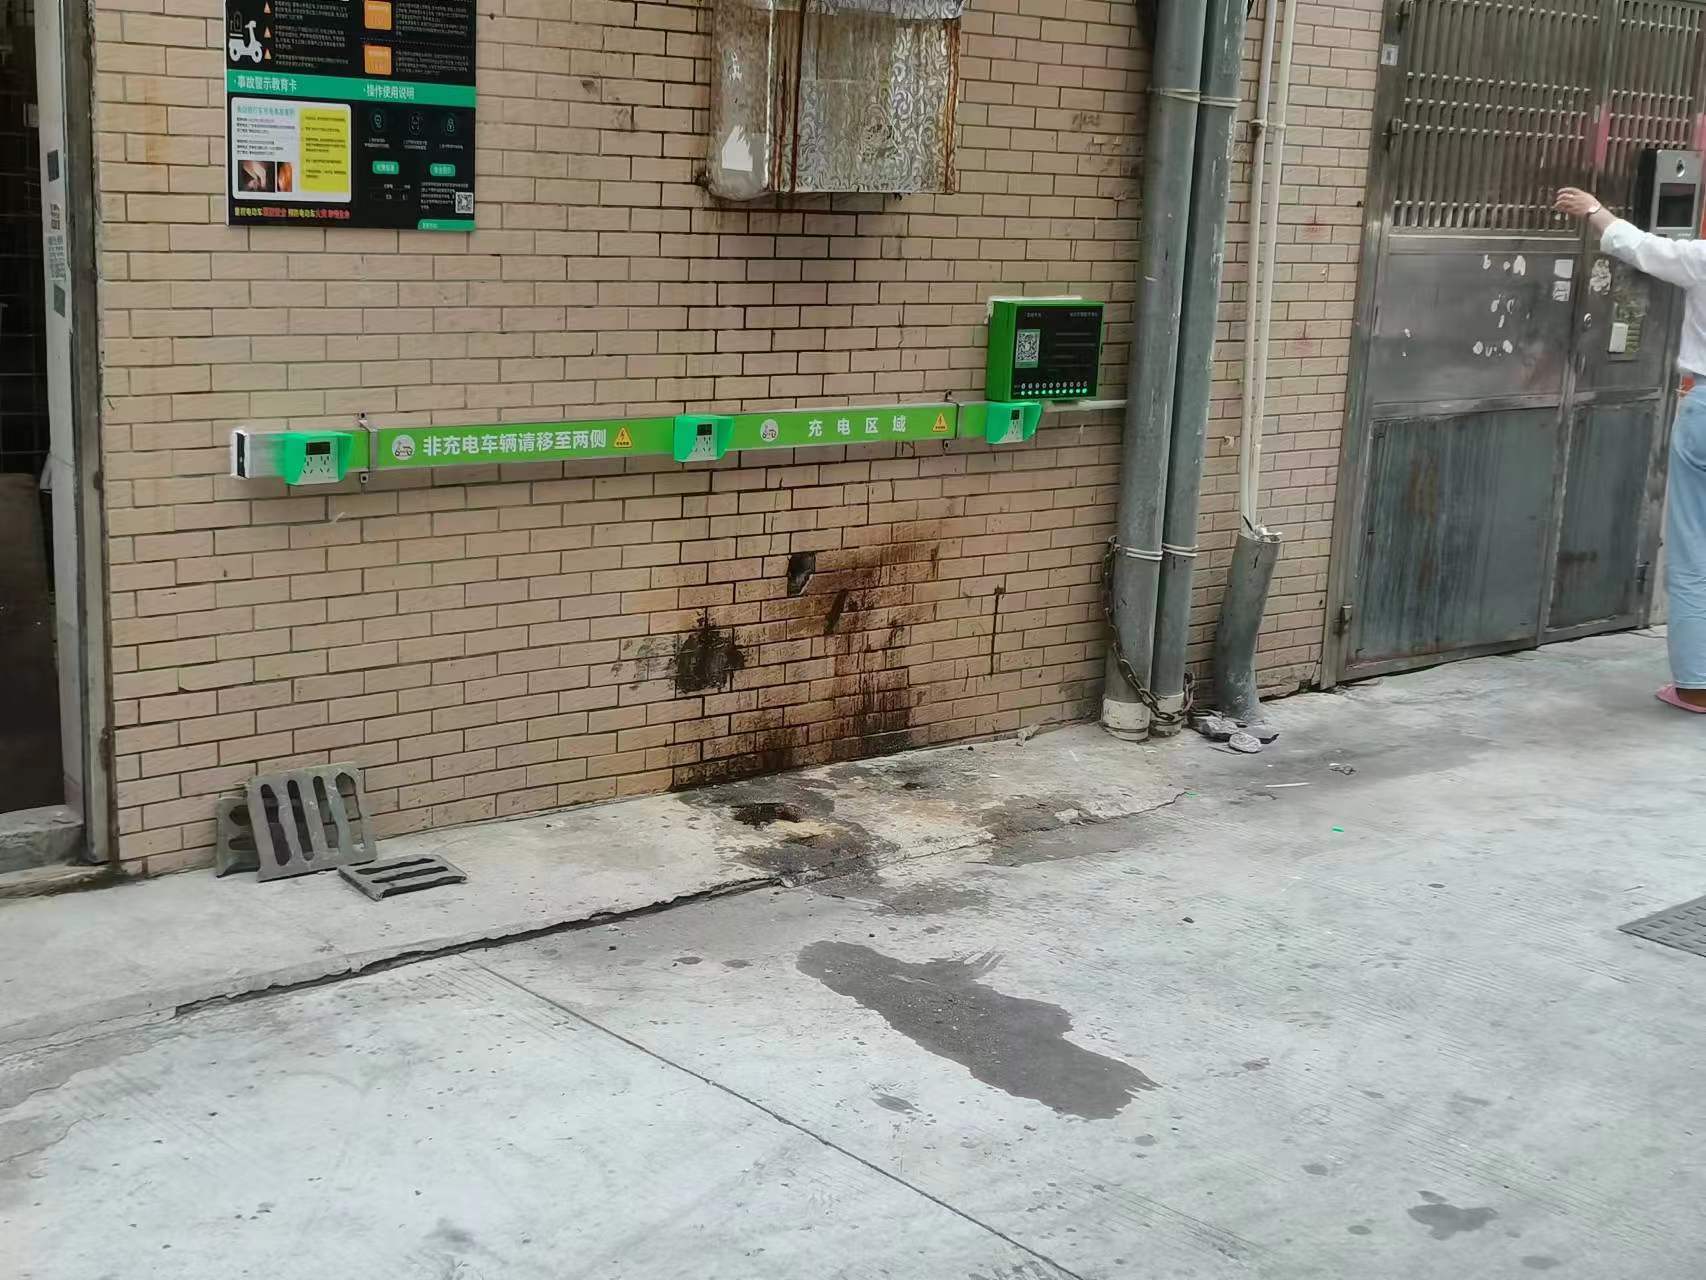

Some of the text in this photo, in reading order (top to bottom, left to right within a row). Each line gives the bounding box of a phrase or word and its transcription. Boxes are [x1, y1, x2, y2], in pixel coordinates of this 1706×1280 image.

[808, 415, 907, 437] 充电区域
[422, 428, 608, 457] 非充电车辆请移至两侧
